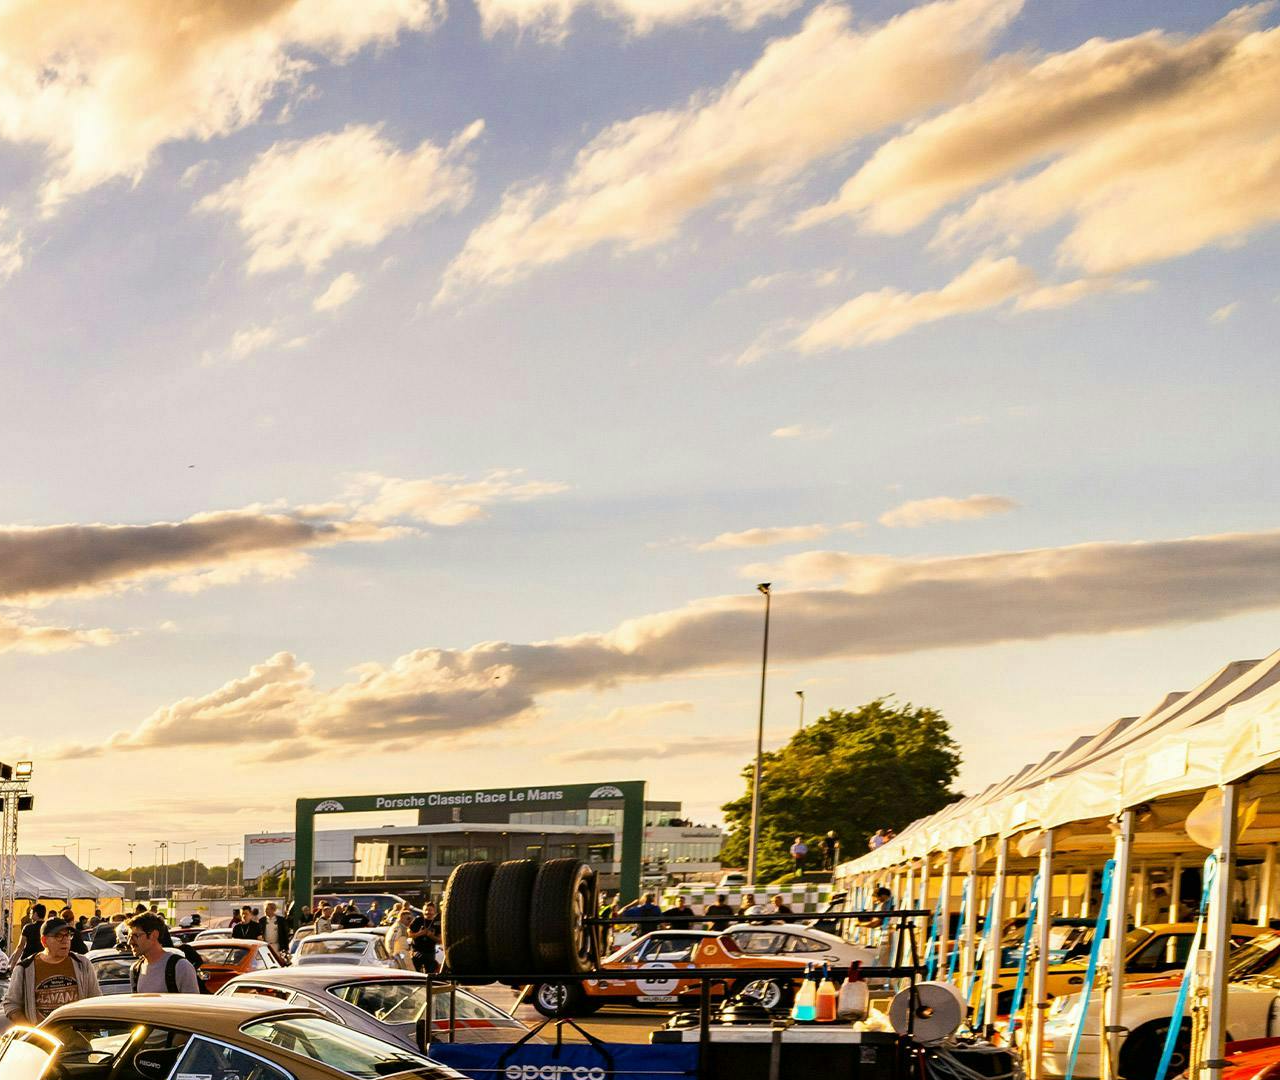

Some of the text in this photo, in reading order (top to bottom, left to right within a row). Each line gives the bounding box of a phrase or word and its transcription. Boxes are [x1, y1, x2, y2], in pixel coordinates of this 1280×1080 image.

[376, 789, 563, 809] Porsche Classic Race Le Mans
